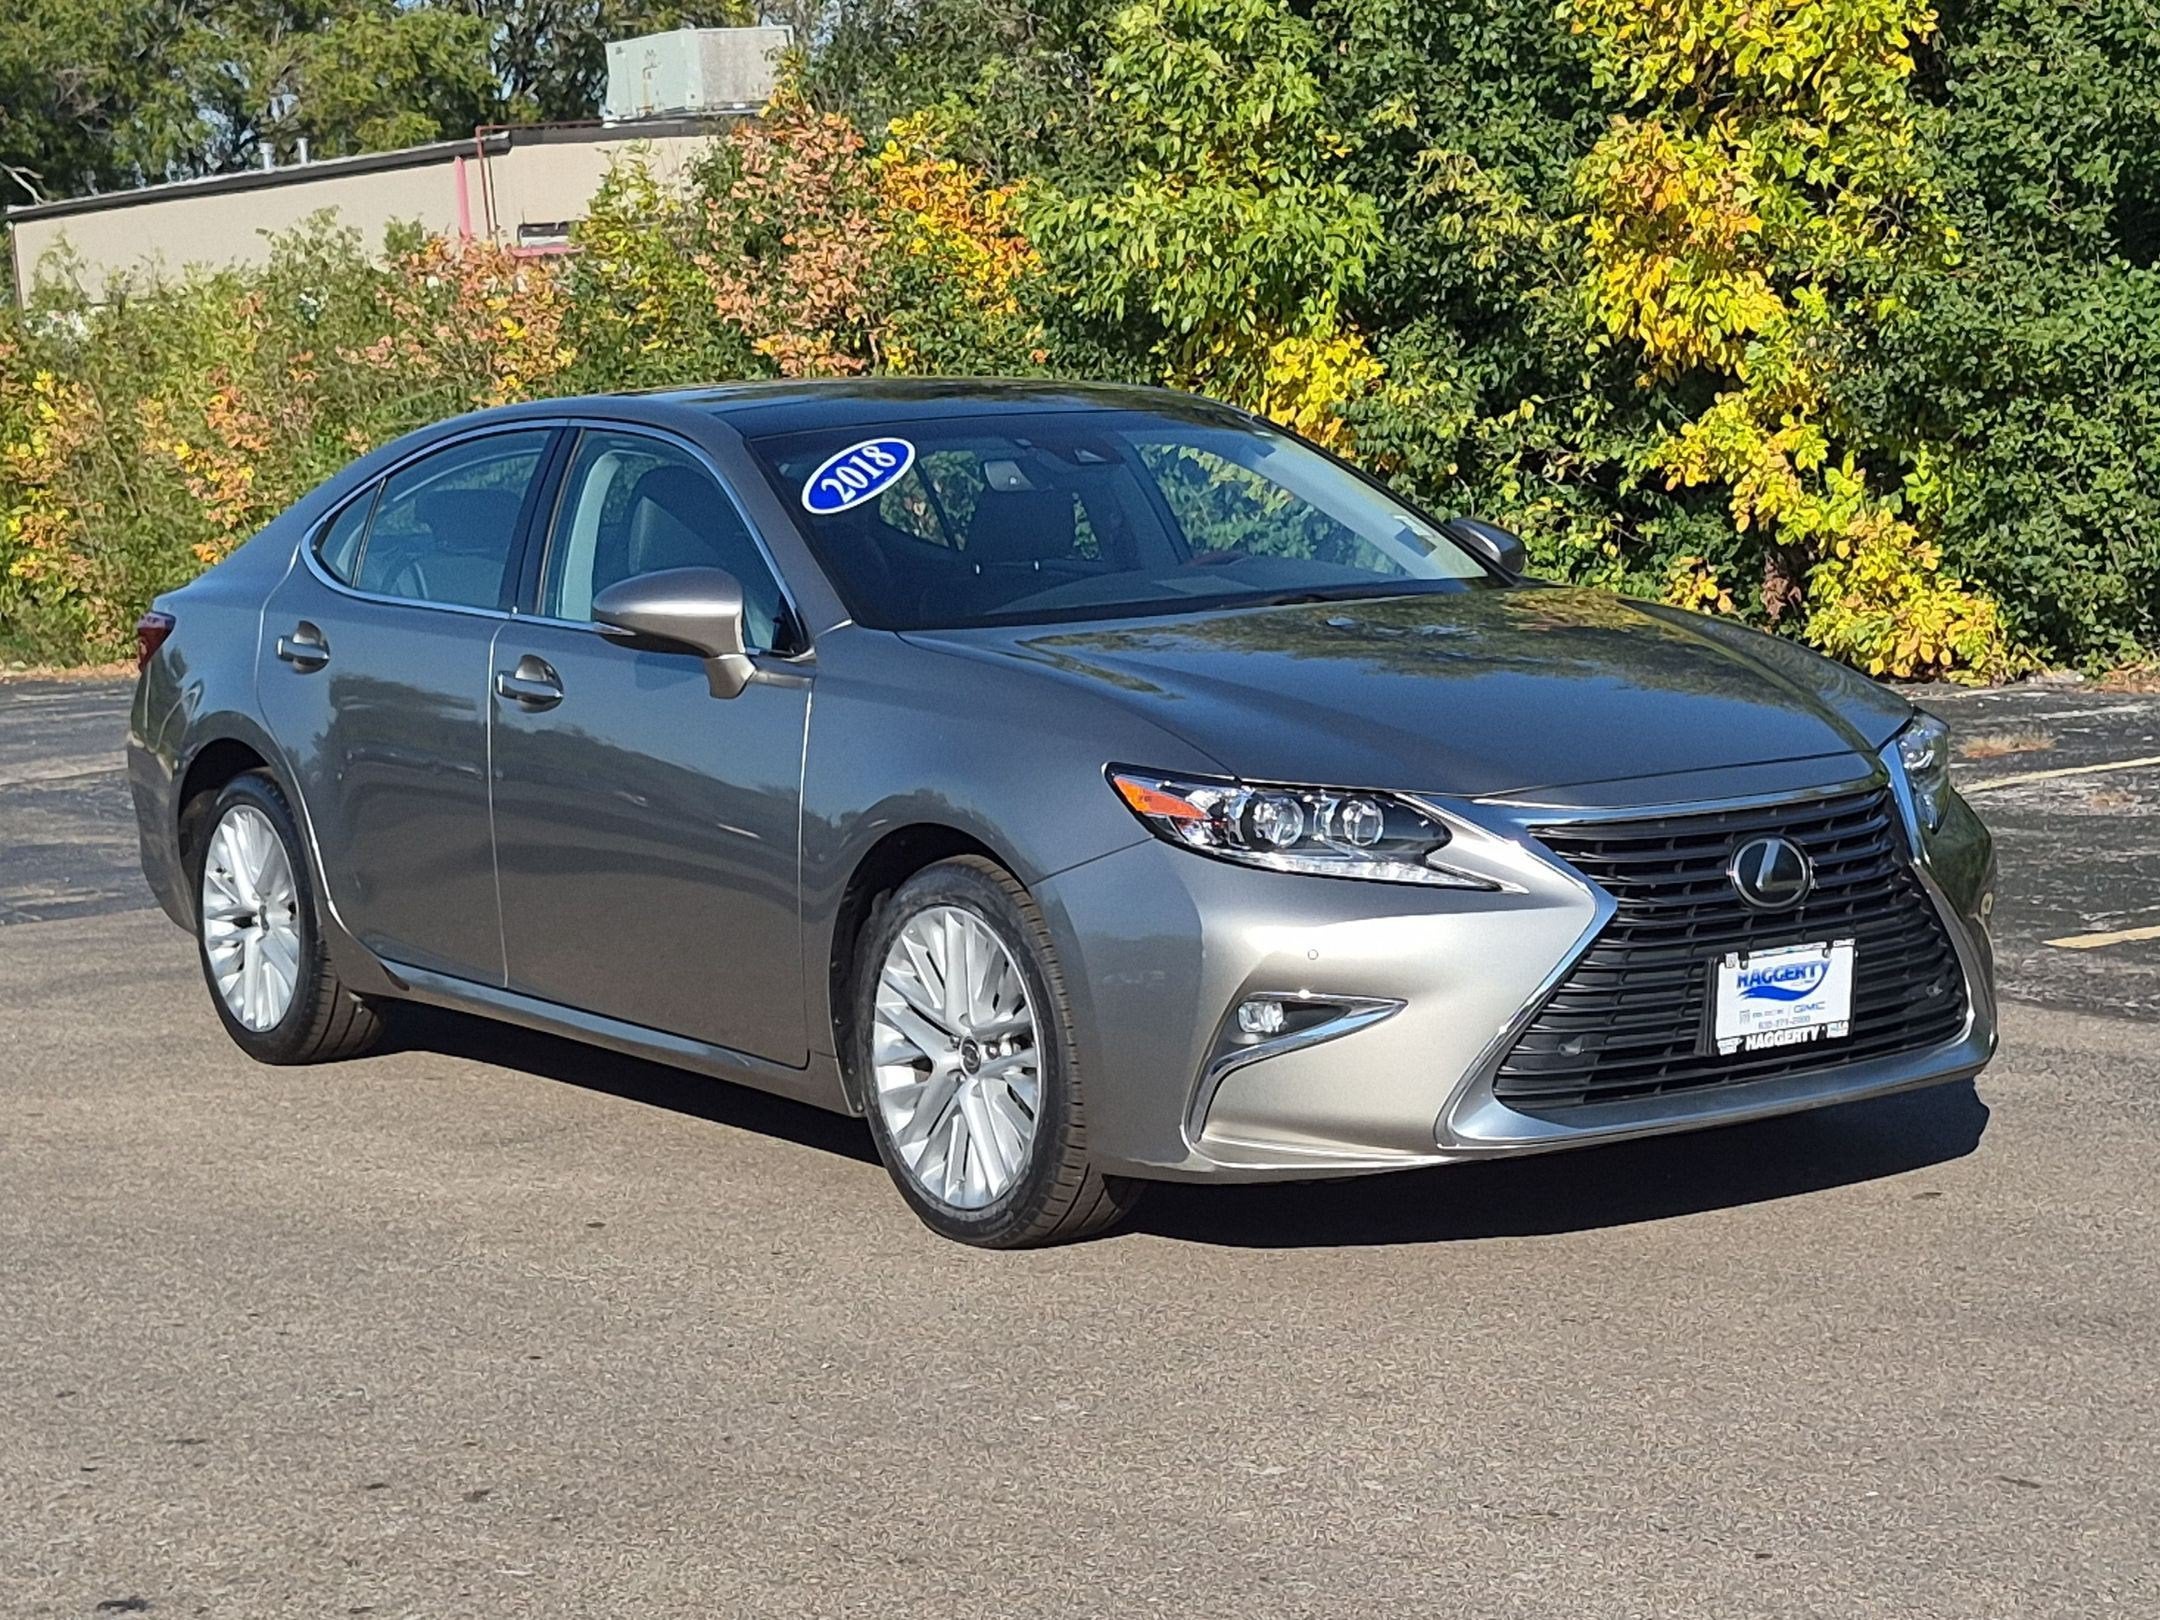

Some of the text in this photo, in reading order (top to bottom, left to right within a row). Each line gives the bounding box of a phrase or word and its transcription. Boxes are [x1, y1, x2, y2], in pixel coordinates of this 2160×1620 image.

[821, 445, 897, 503] 2018
[1737, 960, 1831, 989] HAGGERTY
[1794, 1001, 1826, 1014] GMC
[1745, 1026, 1820, 1051] HAGGERTY
